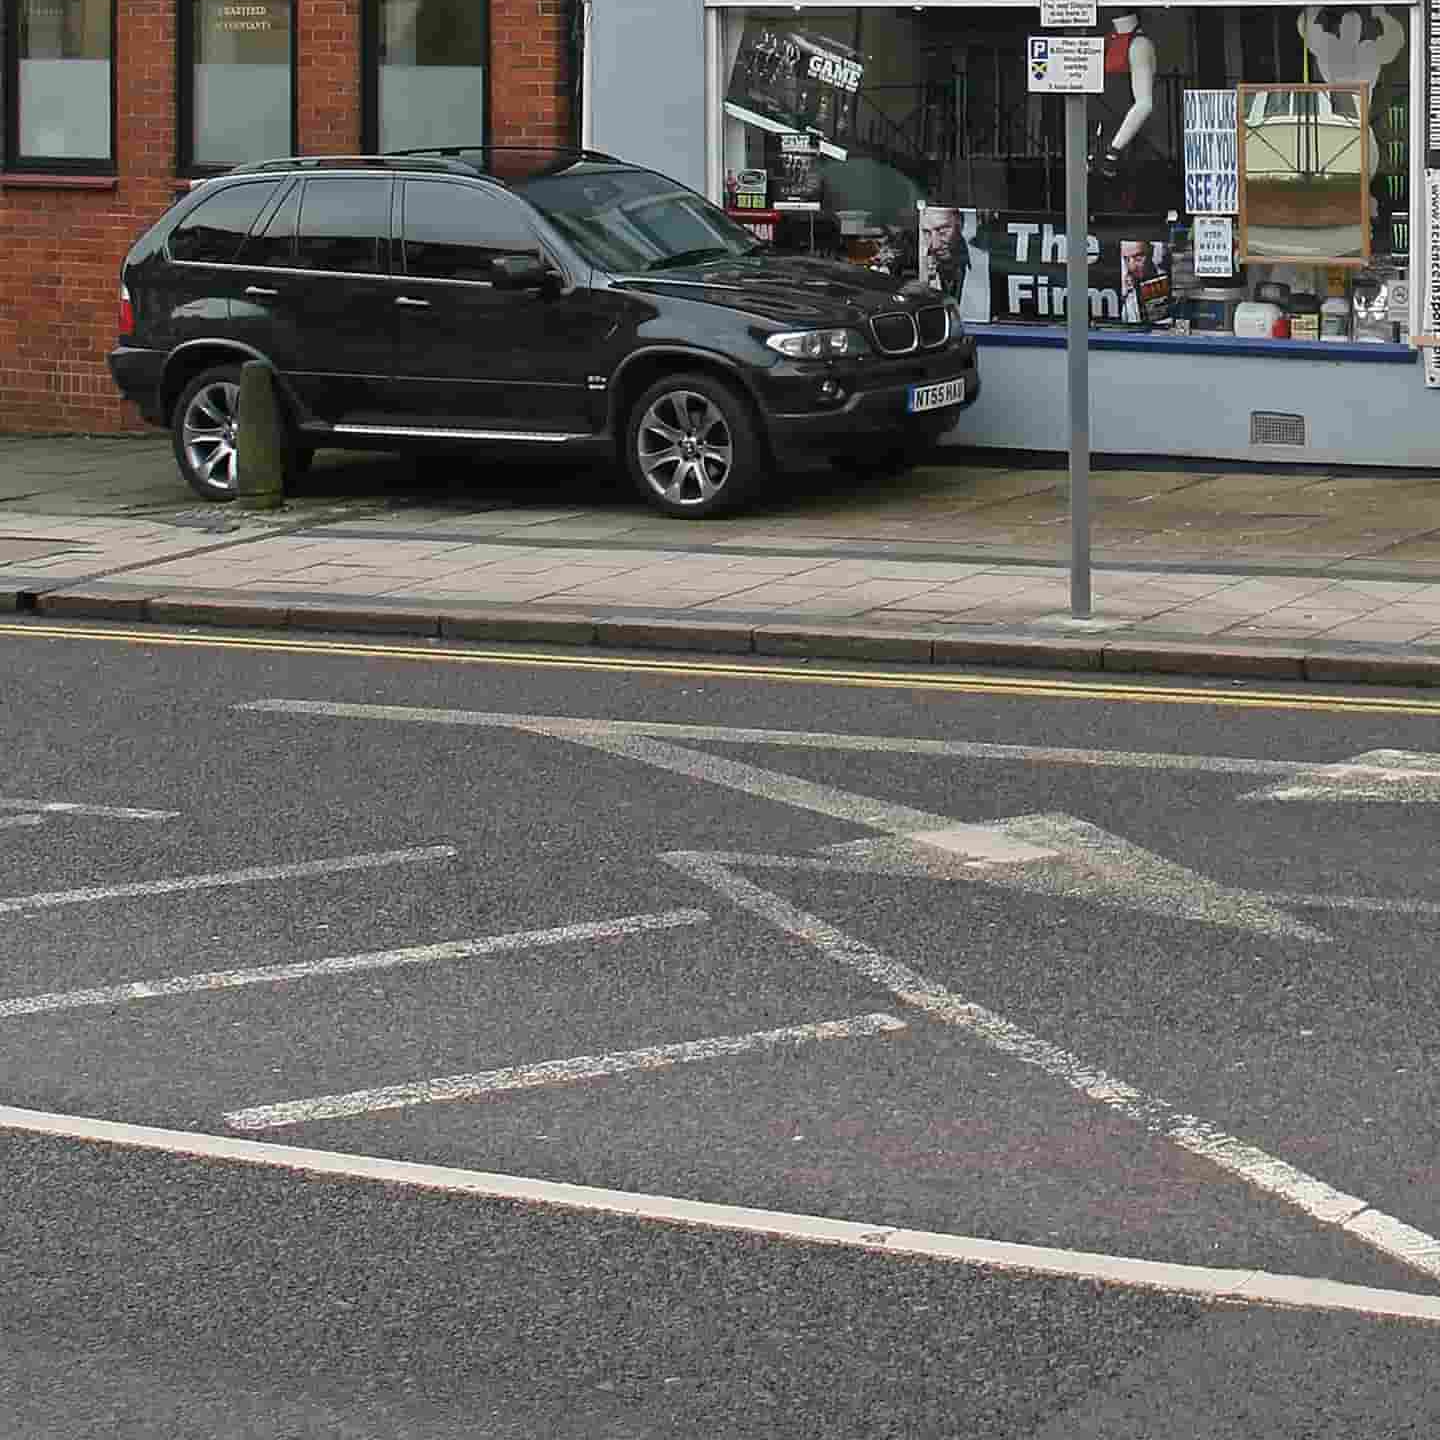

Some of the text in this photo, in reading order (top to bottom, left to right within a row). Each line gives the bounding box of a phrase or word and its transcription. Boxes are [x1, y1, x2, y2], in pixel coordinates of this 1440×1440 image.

[1034, 41, 1046, 58] P
[1185, 132, 1214, 171] WHAT
[1186, 174, 1237, 212] SEE ???
[1007, 274, 1120, 317] Firm
